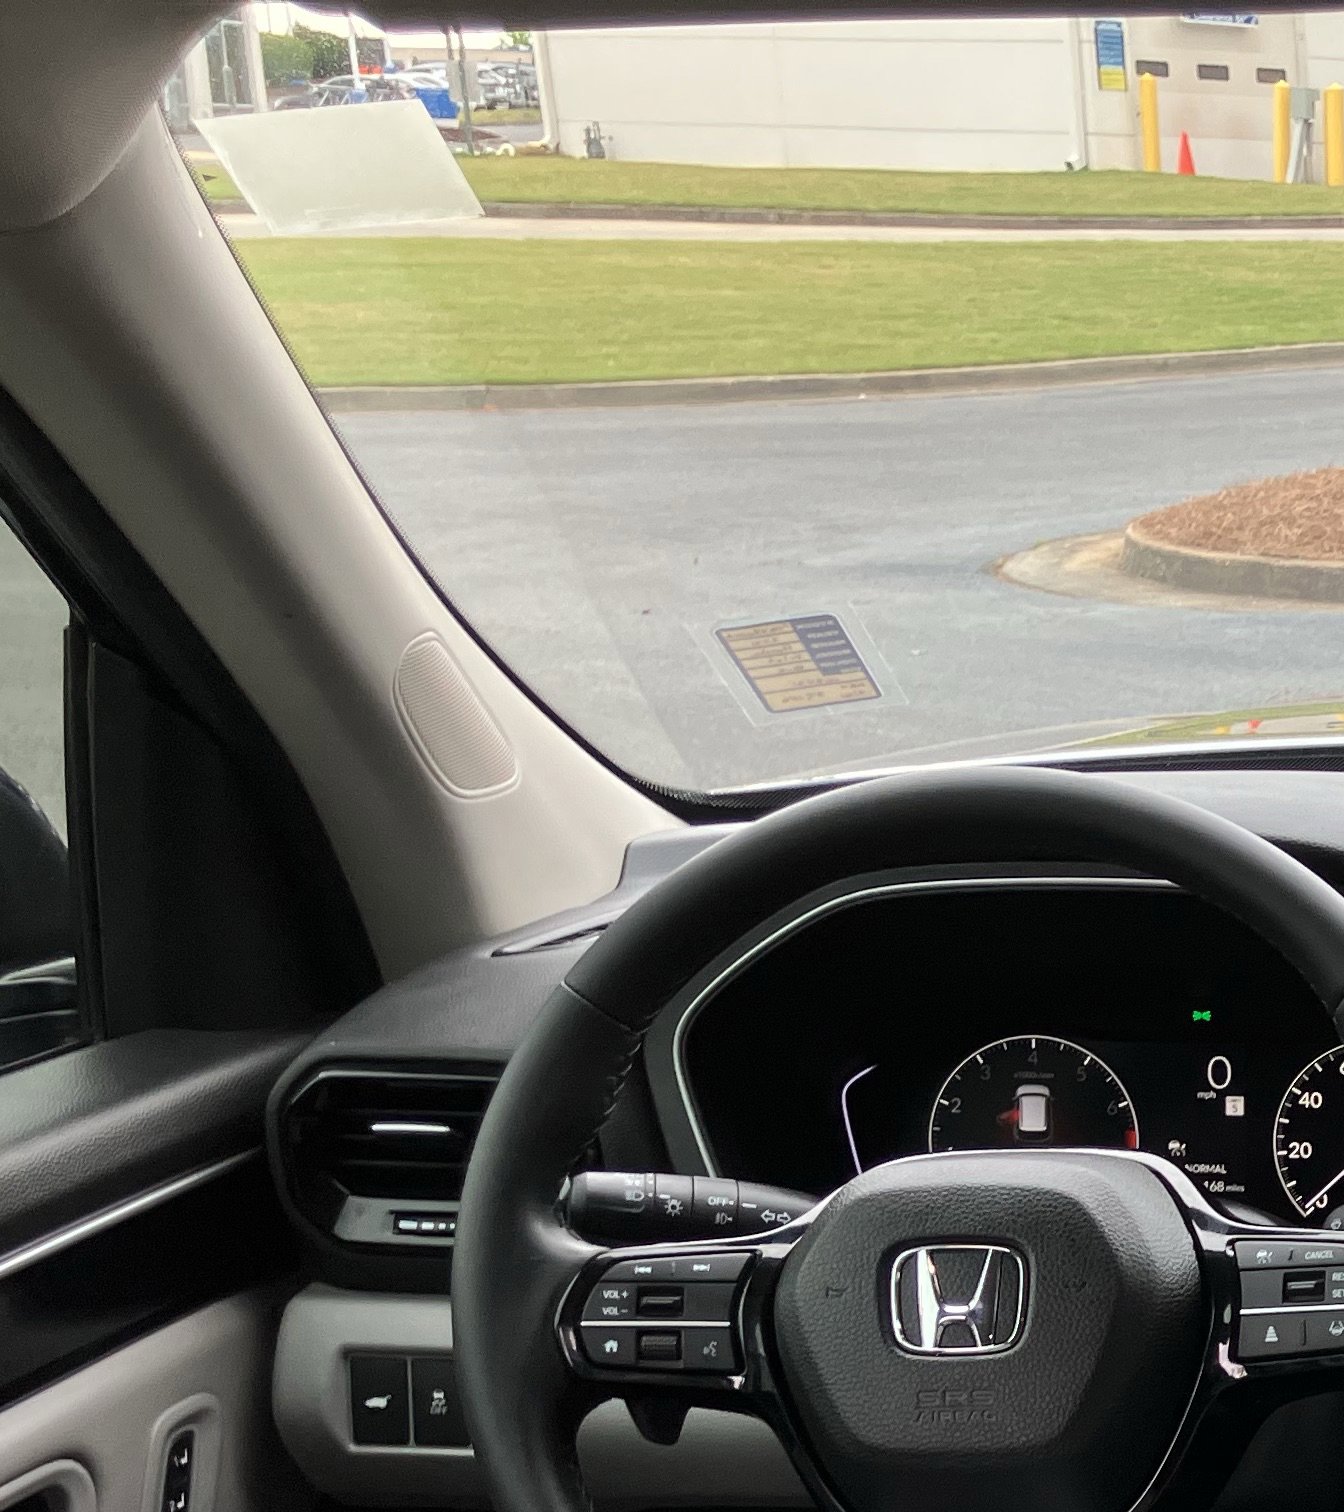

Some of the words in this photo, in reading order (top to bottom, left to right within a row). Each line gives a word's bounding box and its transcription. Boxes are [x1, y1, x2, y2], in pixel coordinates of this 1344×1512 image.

[1028, 1051, 1038, 1065] 4
[981, 1066, 991, 1080] 3
[1077, 1068, 1087, 1082] 5
[1208, 1056, 1231, 1089] 0
[1197, 1090, 1216, 1100] mph
[1299, 1092, 1322, 1108] 40
[951, 1100, 961, 1113] 2
[1107, 1102, 1117, 1115] 6
[1289, 1142, 1312, 1158] 20
[1305, 1251, 1334, 1260] CANCEL
